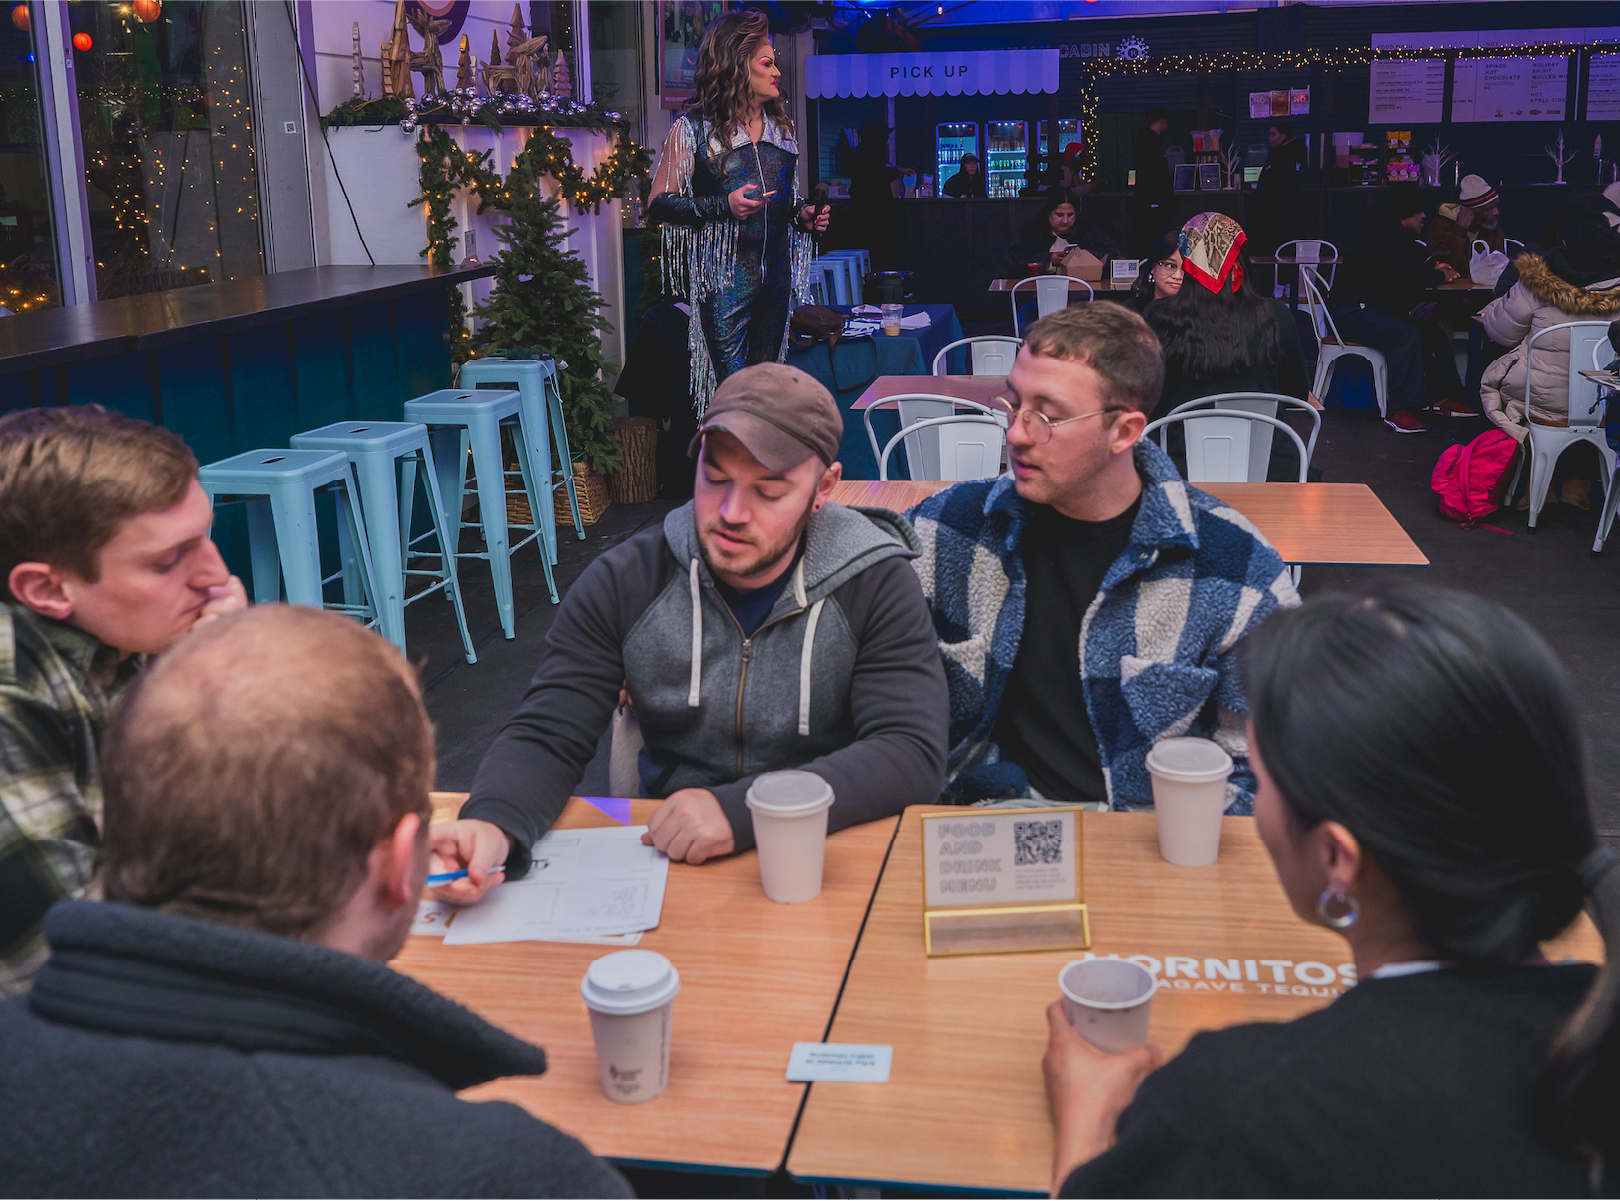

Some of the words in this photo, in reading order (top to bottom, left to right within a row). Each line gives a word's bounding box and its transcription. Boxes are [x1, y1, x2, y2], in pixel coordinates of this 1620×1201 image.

[1058, 43, 1110, 58] CABIN
[890, 66, 934, 79] PICK
[944, 65, 968, 77] UP
[1252, 96, 1266, 104] NO
[937, 822, 996, 839] FOOD
[938, 840, 984, 856] AND
[938, 858, 1003, 875] DRINK
[939, 877, 997, 894] MENU
[1084, 952, 1358, 988] ORNITOS
[1156, 978, 1246, 993] AGAVE
[1256, 983, 1346, 999] TEQUI
